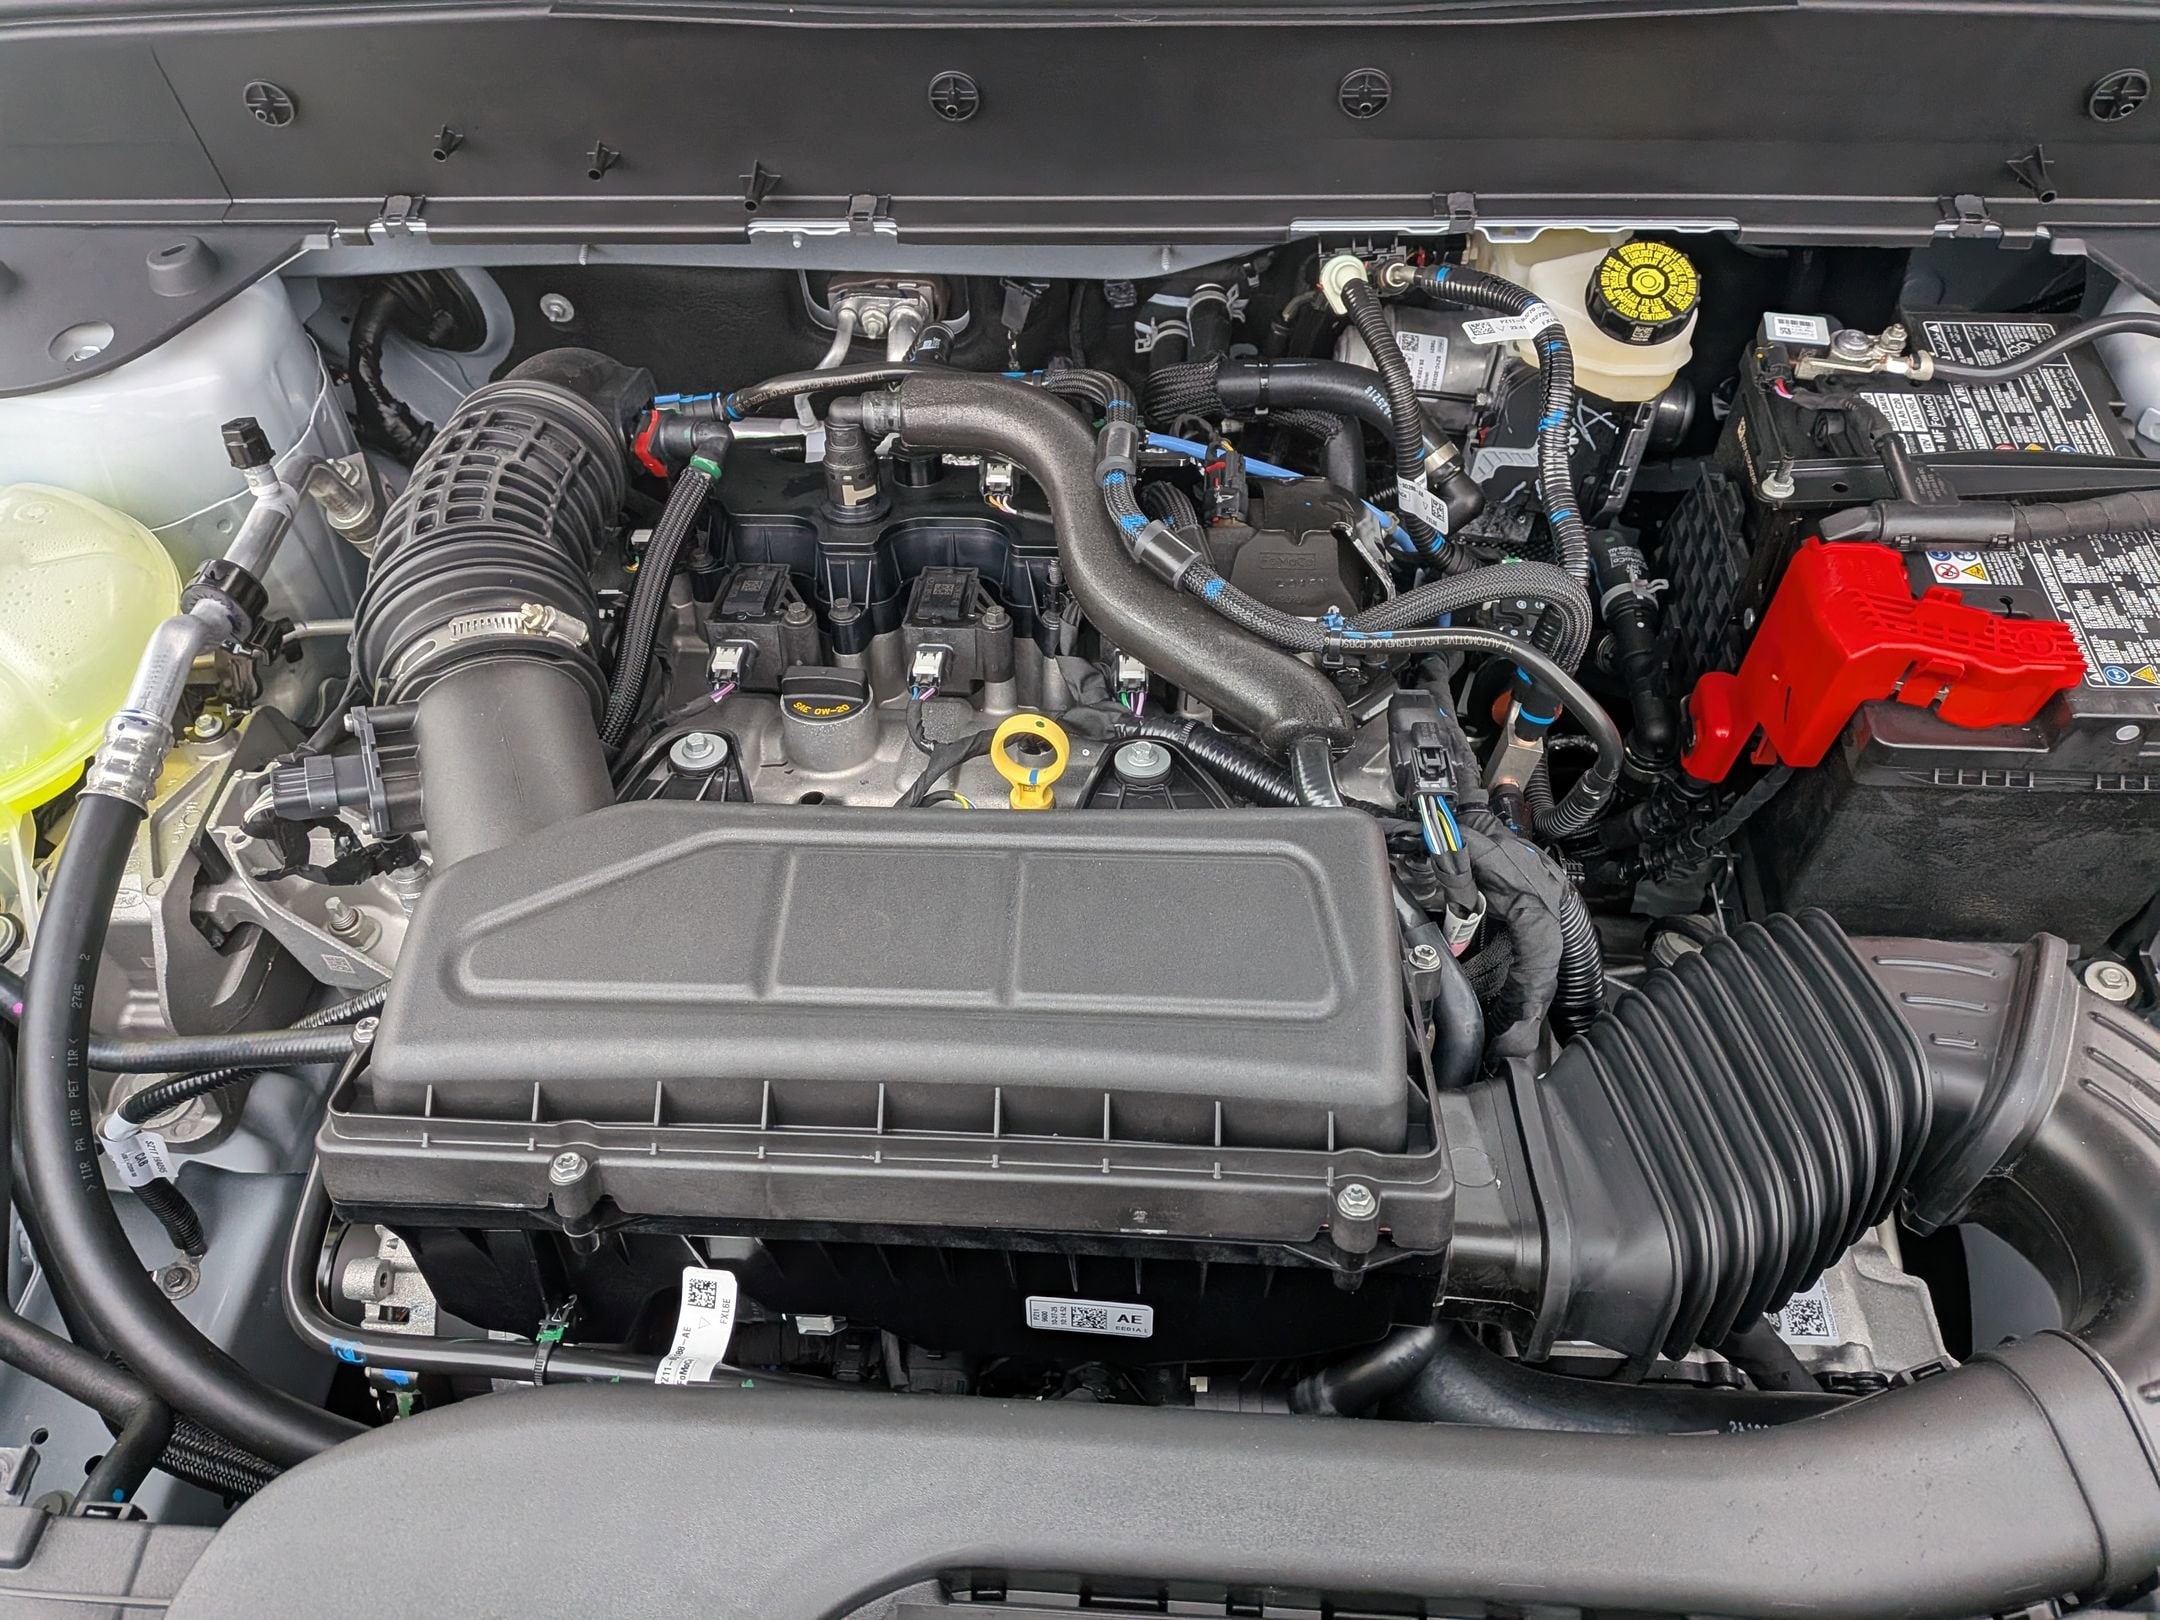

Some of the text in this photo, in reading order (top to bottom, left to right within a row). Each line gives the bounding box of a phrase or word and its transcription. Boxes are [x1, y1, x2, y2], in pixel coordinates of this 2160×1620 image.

[1918, 395, 1944, 426] FoMoCo
[793, 702, 812, 713] SAE
[71, 984, 85, 1009] 2745
[68, 1079, 80, 1099] PET
[75, 1137, 85, 1152] PA
[134, 1152, 149, 1167] CAB
[720, 1298, 731, 1325] FXL6E
[1116, 1314, 1143, 1325] AE
